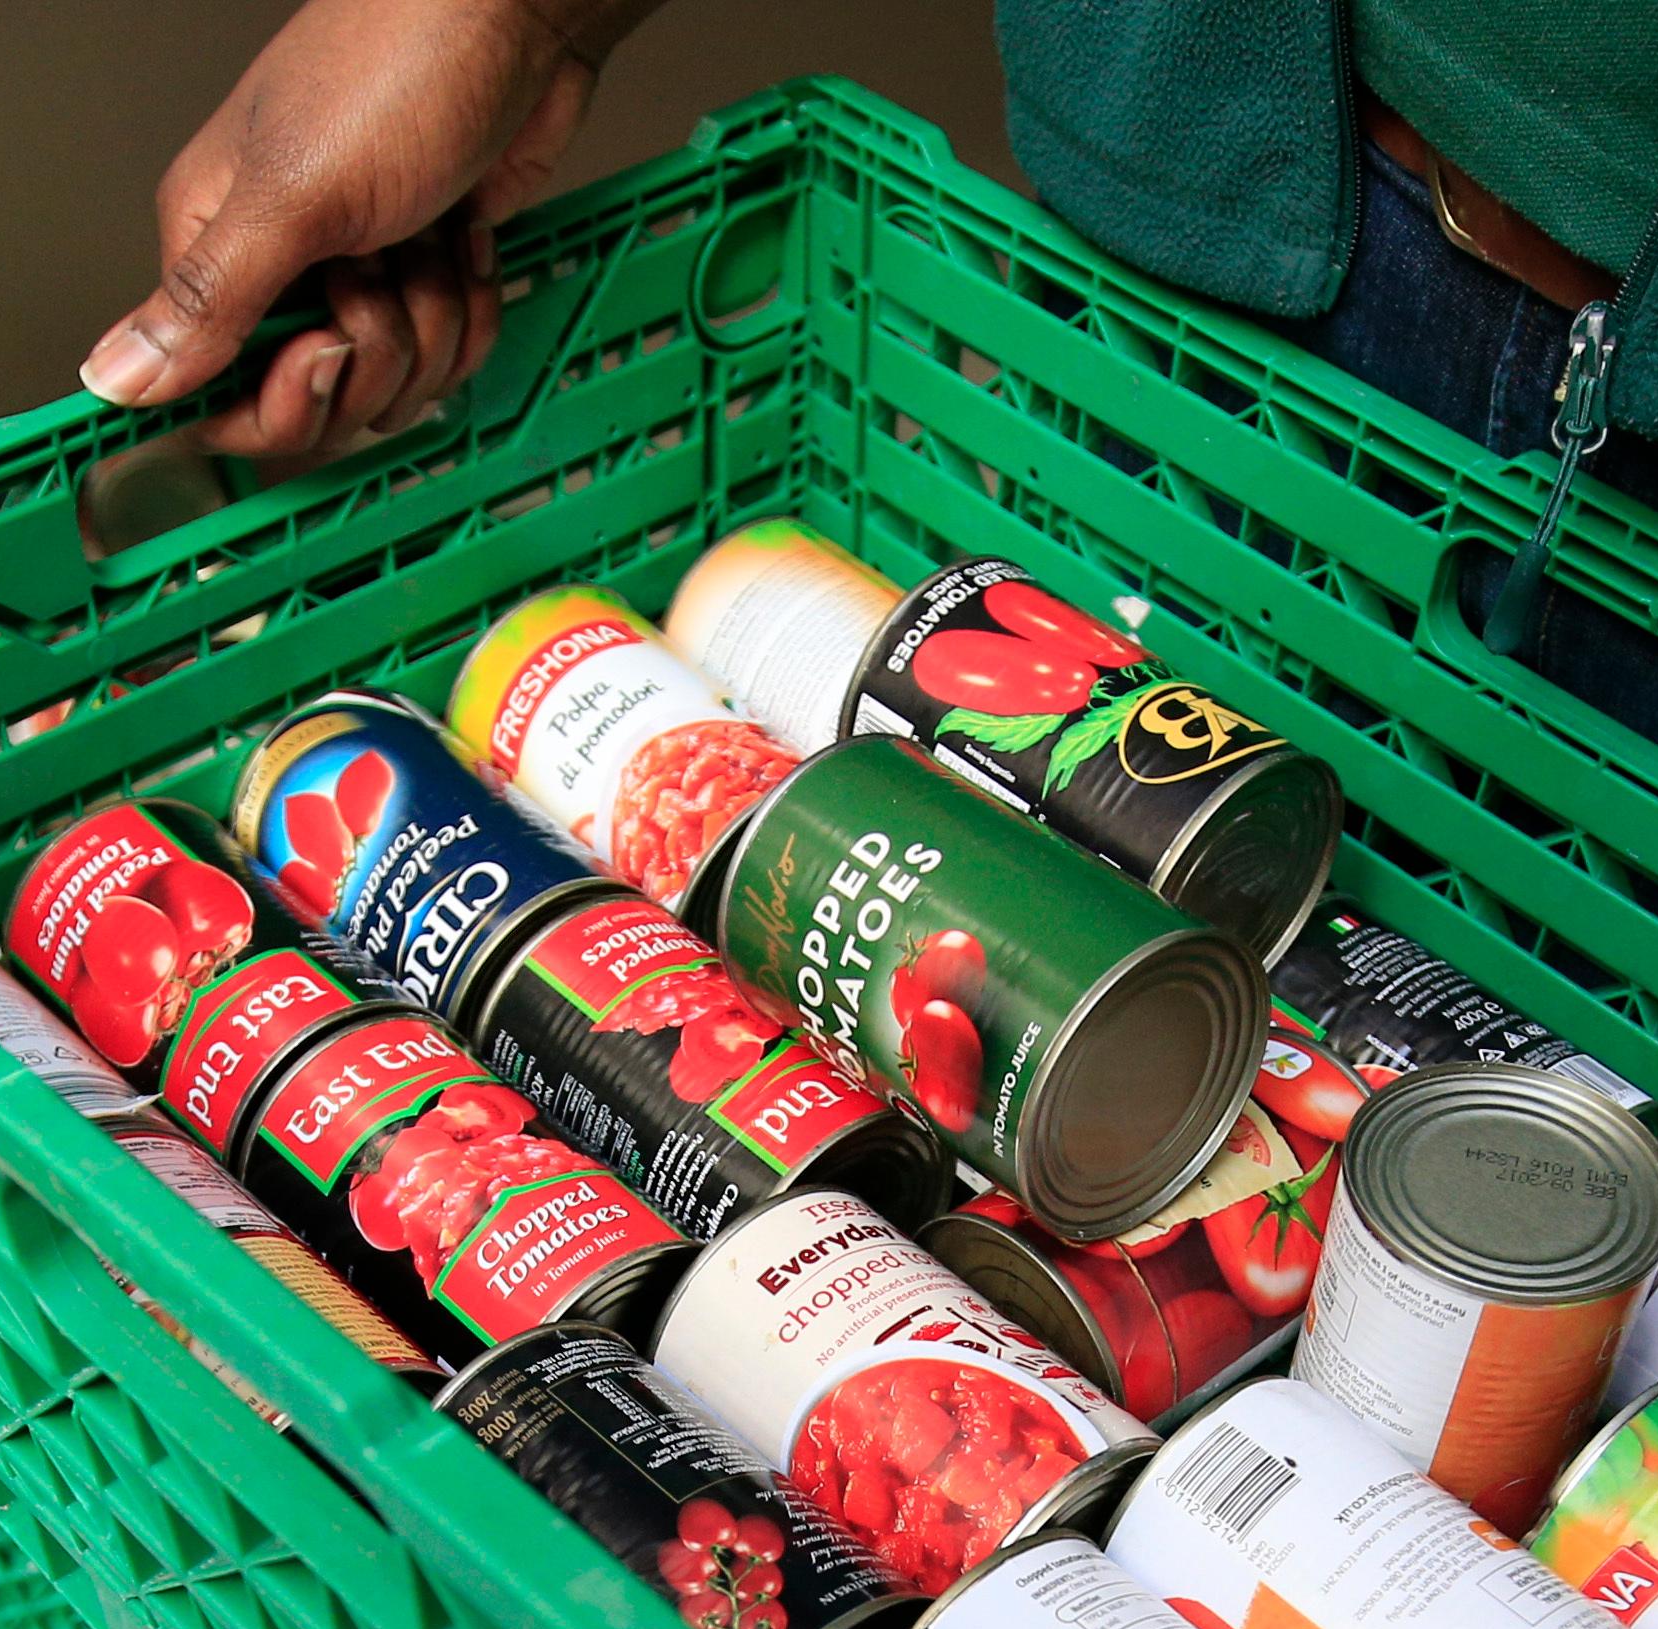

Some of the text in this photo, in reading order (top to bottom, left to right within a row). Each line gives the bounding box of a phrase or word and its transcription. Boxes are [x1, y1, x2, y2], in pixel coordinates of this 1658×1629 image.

[923, 569, 964, 603] JUICE
[884, 578, 978, 676] TOMATOES
[492, 623, 627, 758] FRESHONA
[547, 680, 611, 737] Polpa
[556, 678, 664, 790] di pomodori
[38, 837, 142, 951] Tomatoes
[51, 846, 87, 885] Tomato
[348, 821, 429, 942] Tomatoes
[366, 814, 480, 960] Peeled Plu
[51, 846, 171, 981] Peeled Plum
[1453, 1003, 1491, 1033] 400g
[181, 970, 327, 1130] East End
[285, 1064, 373, 1145] East
[363, 1032, 456, 1070] End
[753, 1081, 843, 1144] End
[993, 1021, 1042, 1157] IN TOMATO JUICE
[660, 1131, 689, 1173] Tomates
[669, 1132, 705, 1181] Pomodori
[691, 1152, 720, 1194] Tomates
[475, 1181, 600, 1270] Chopped
[486, 1200, 631, 1300] Tomatoes
[532, 1228, 627, 1297] in Tomato Juice
[757, 1224, 892, 1296] Everyday
[1397, 1278, 1424, 1298] your
[777, 1251, 902, 1344] chopped
[847, 1276, 904, 1314] Produced
[816, 1345, 838, 1368] No
[836, 1306, 886, 1349] artificial
[455, 1389, 496, 1428] 260g
[475, 1406, 519, 1447] 400g
[1334, 1471, 1422, 1525] ainsburys.co.uk
[1344, 1507, 1376, 1538] more?
[1353, 1527, 1386, 1560] London
[1015, 1562, 1054, 1589] Chopped
[1383, 1590, 1417, 1624] simply
